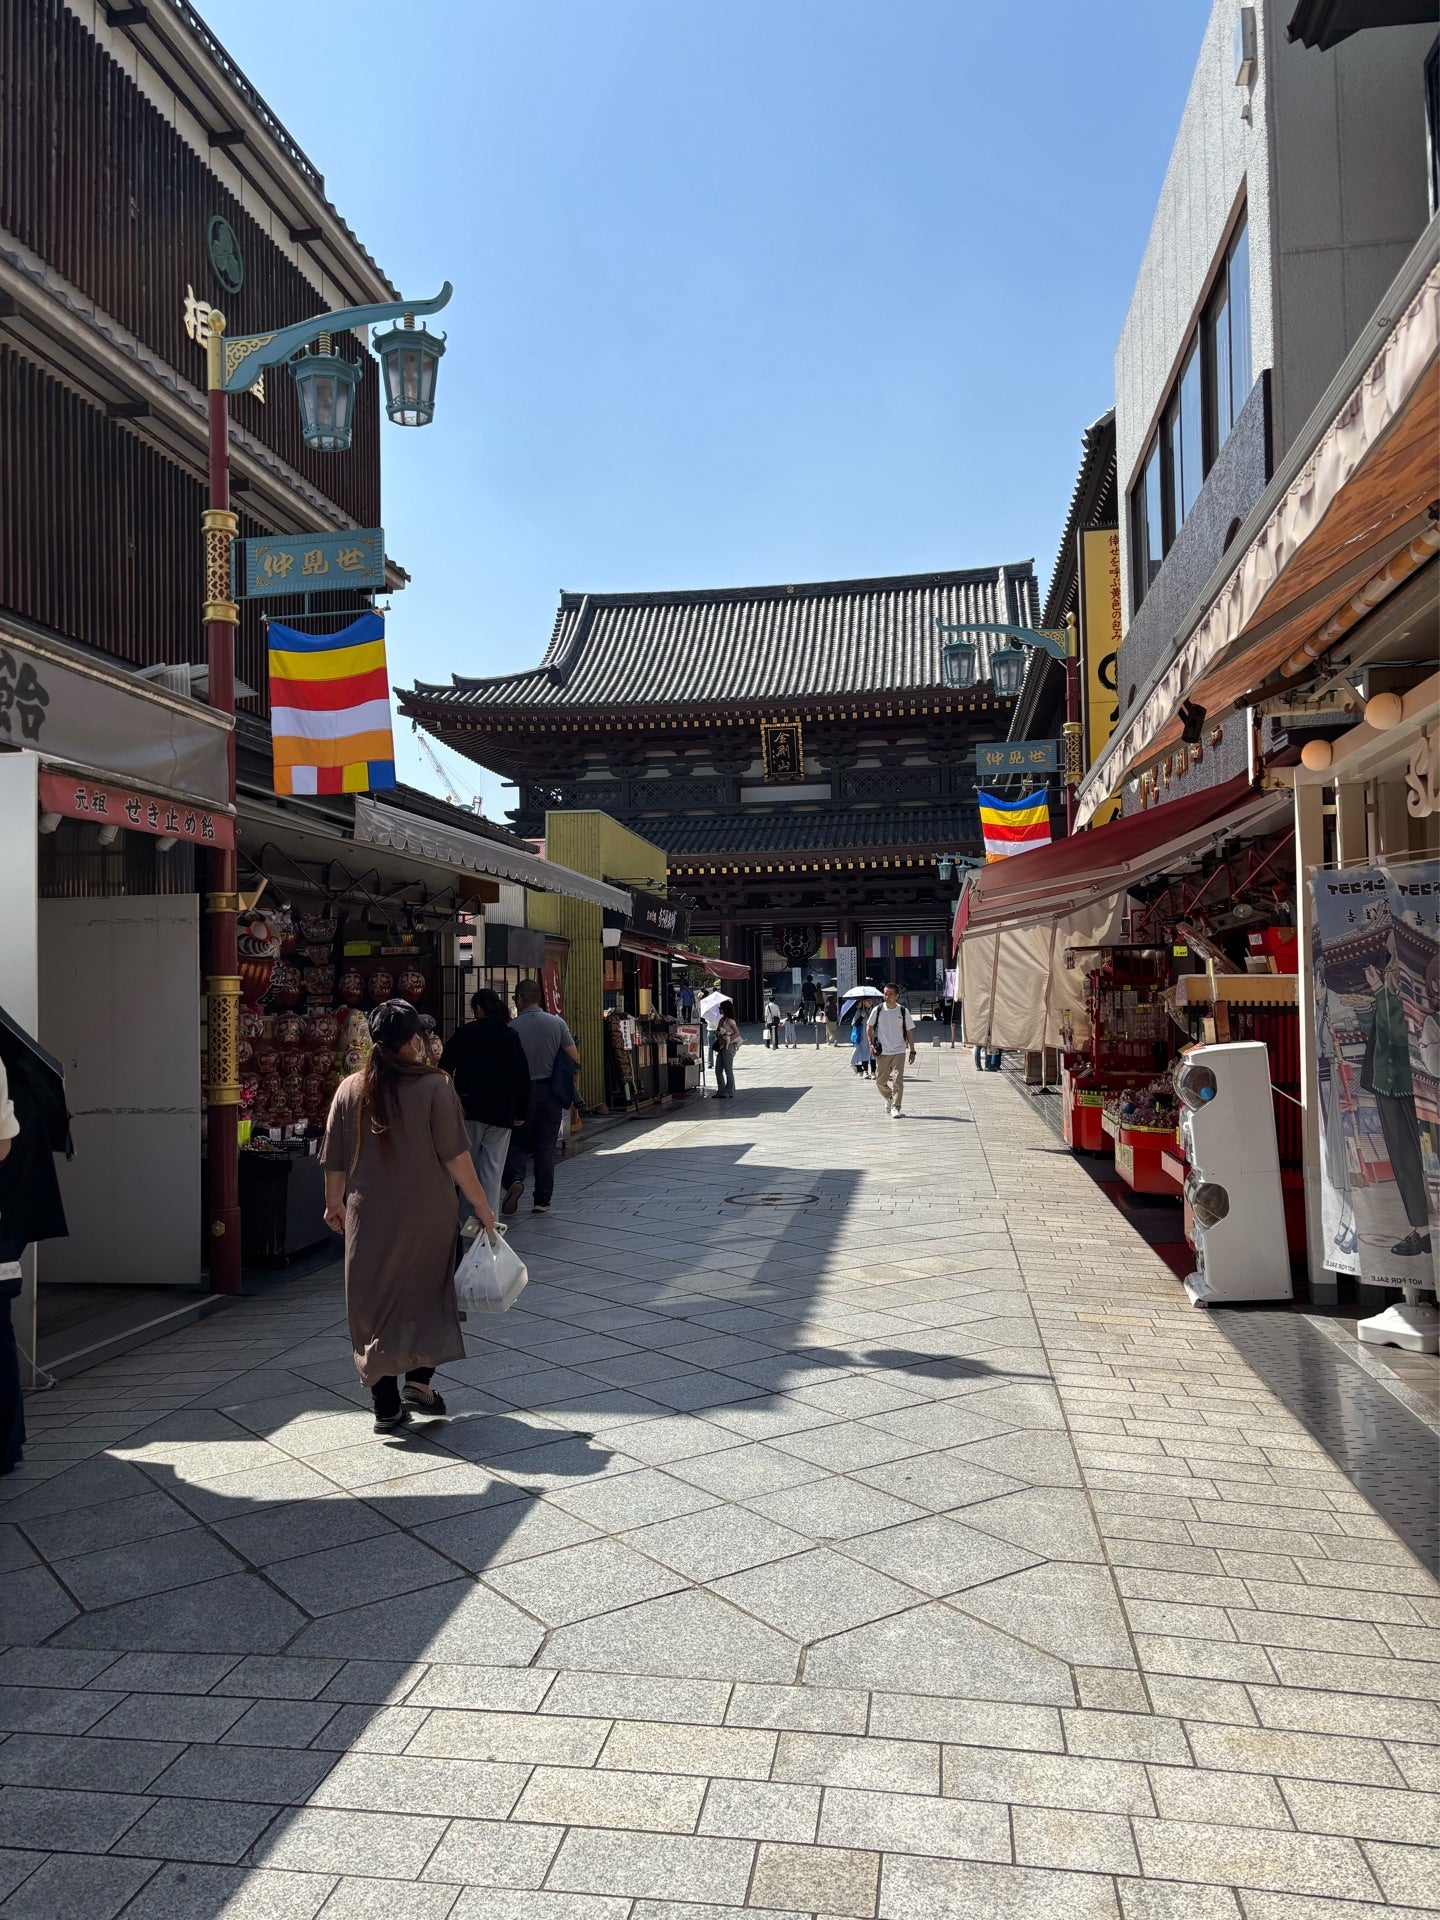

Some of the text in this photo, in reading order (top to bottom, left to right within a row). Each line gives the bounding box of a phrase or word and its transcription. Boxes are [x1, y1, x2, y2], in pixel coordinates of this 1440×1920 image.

[263, 547, 366, 579] 仲見世
[774, 731, 790, 771] 金剛山
[985, 749, 1047, 766] 仲見世
[75, 788, 215, 841] 元祖 せき止め飴
